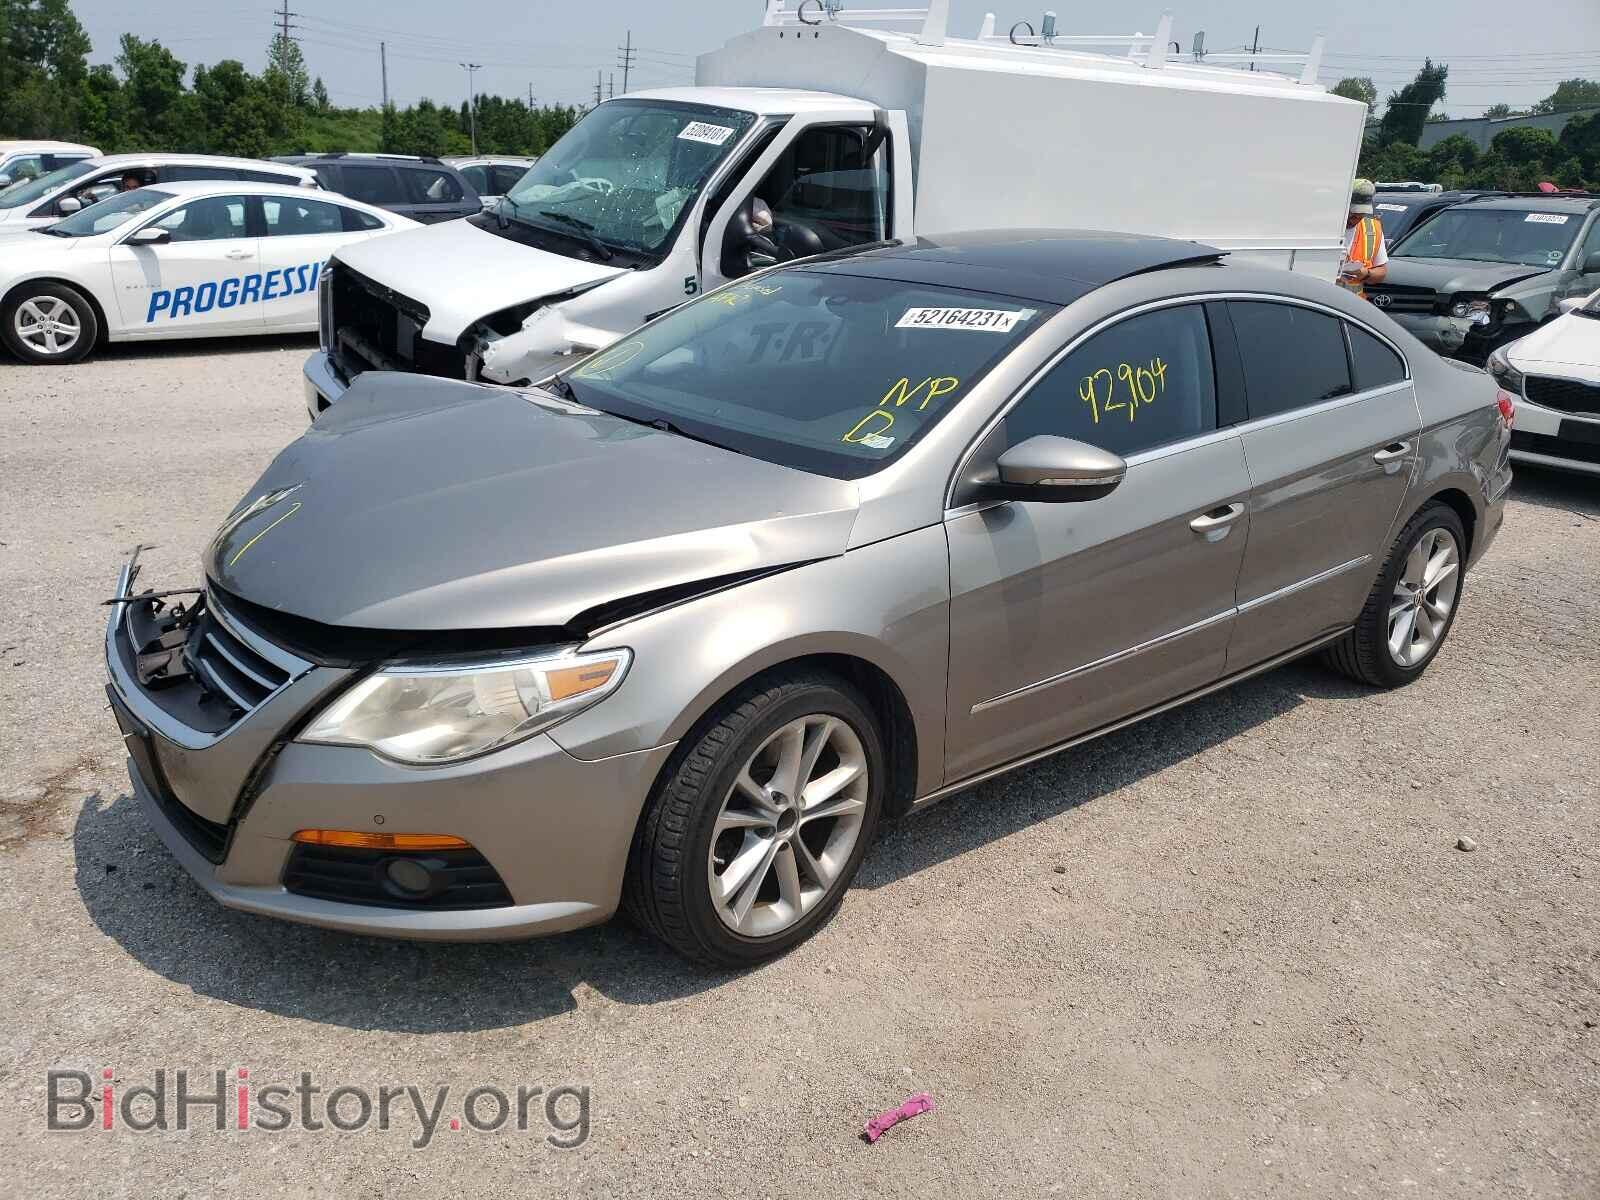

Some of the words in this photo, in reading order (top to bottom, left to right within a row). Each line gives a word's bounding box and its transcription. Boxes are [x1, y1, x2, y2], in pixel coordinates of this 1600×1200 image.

[146, 261, 325, 323] PROGRESSI
[684, 276, 698, 295] 5
[879, 377, 959, 410] NP
